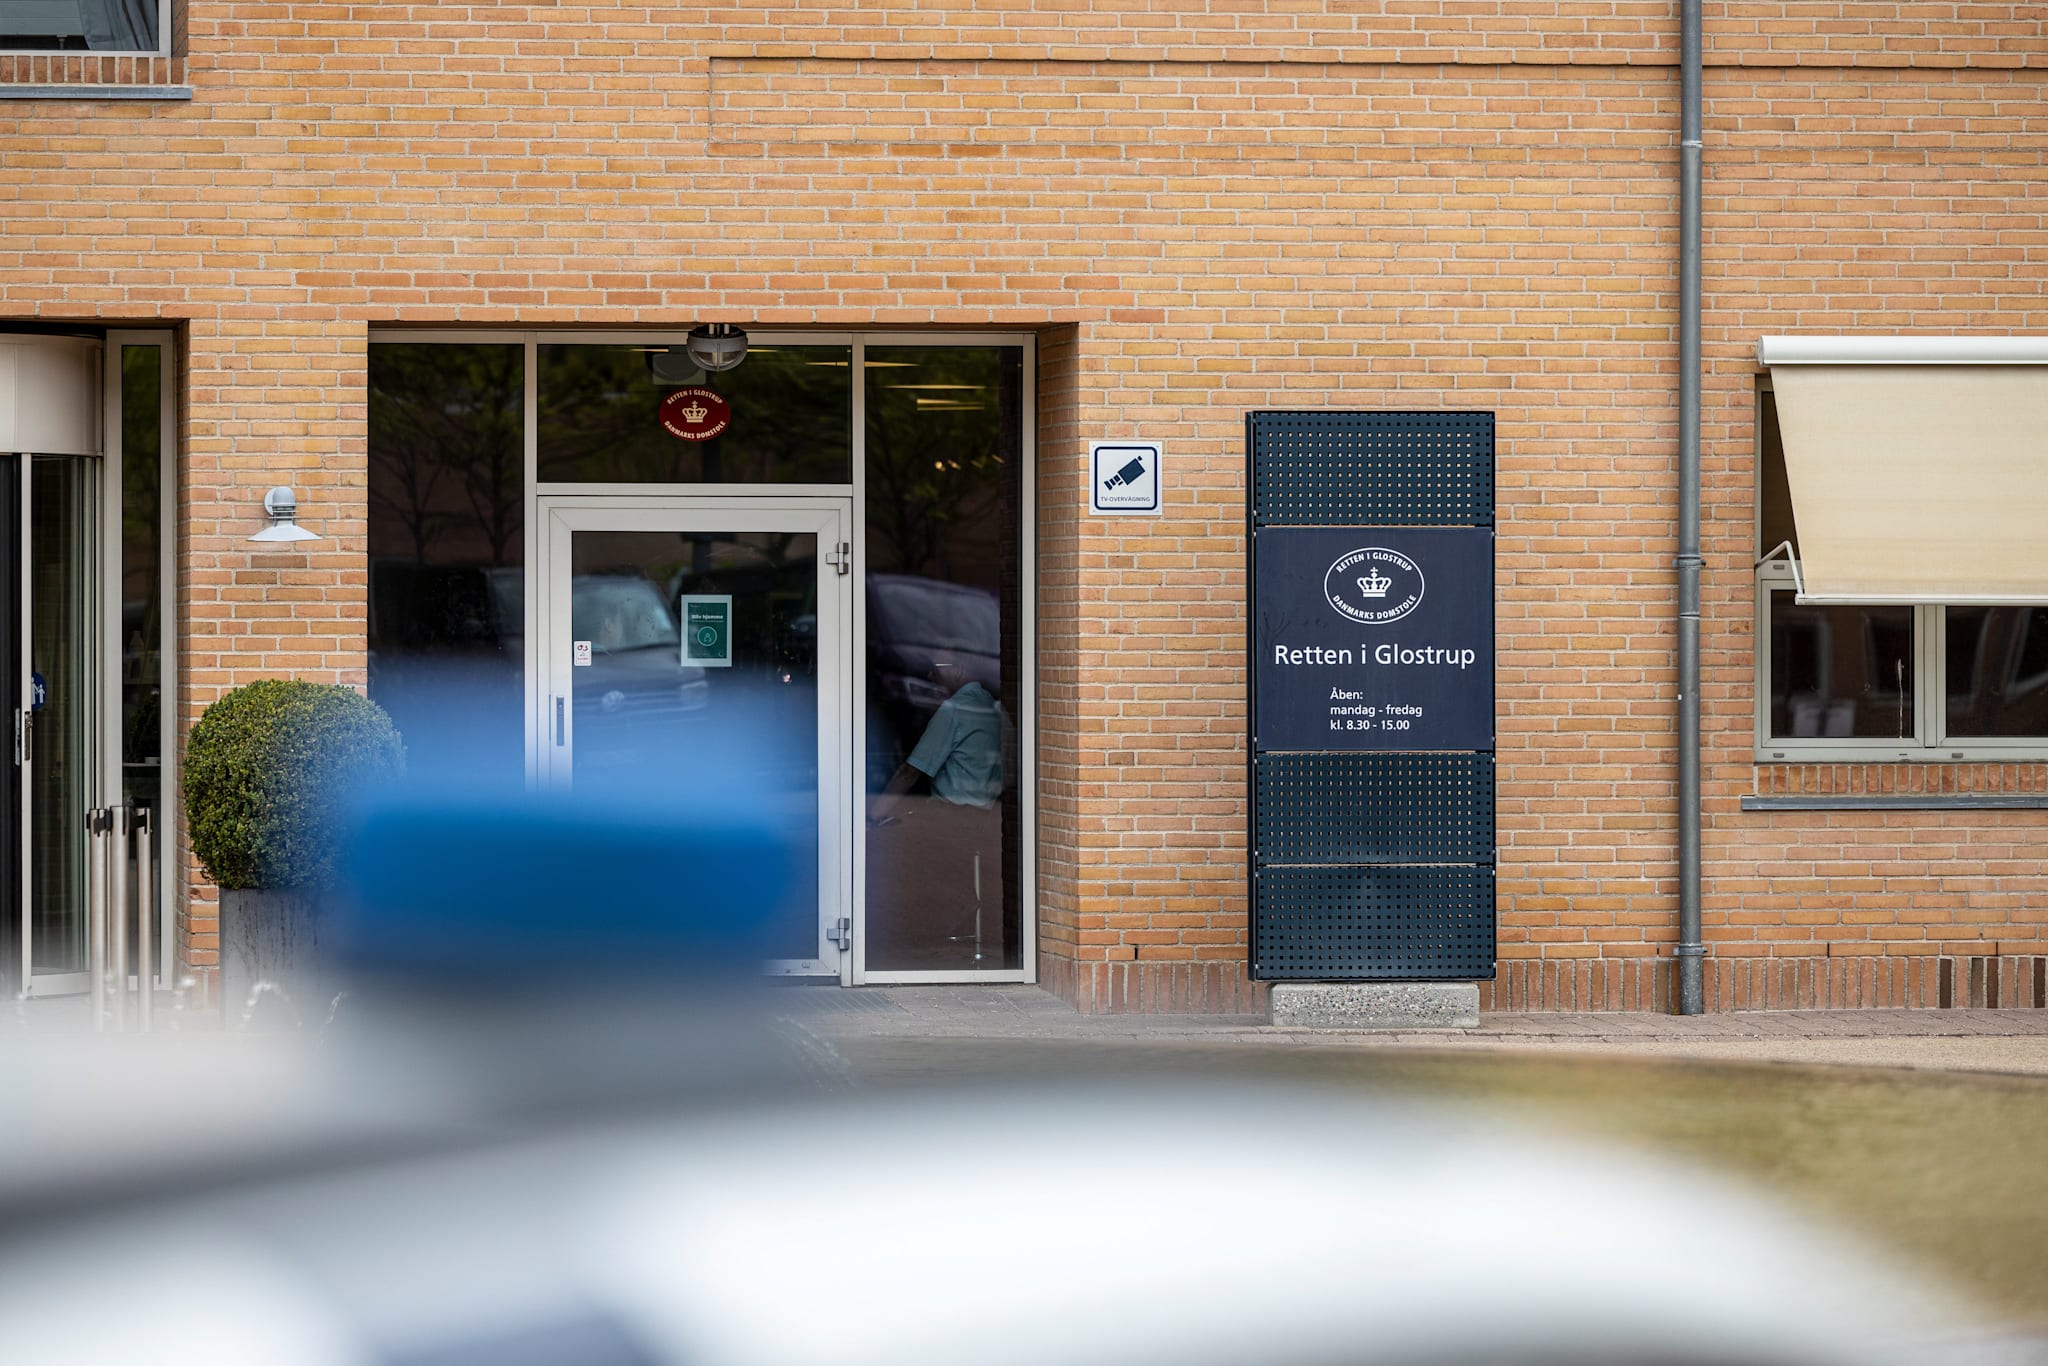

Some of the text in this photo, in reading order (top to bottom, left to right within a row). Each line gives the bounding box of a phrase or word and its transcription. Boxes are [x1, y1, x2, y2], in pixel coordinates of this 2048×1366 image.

[666, 390, 688, 405] RETTEN
[693, 389, 723, 404] GLOSTRUP
[664, 420, 726, 439] DANMARKS DOMSTOLE
[1335, 552, 1412, 573] RETTEN I GLOSTRUP
[1332, 594, 1417, 620] DANMARKS DOMSTOLE
[1275, 643, 1476, 670] Retten i Glostrup
[1330, 686, 1363, 700] Åben:
[1330, 704, 1376, 718] mandag
[1385, 704, 1423, 718] fredag
[1330, 719, 1343, 730] kl.
[1346, 719, 1370, 730] 8.30
[1381, 719, 1410, 730] 15.00
